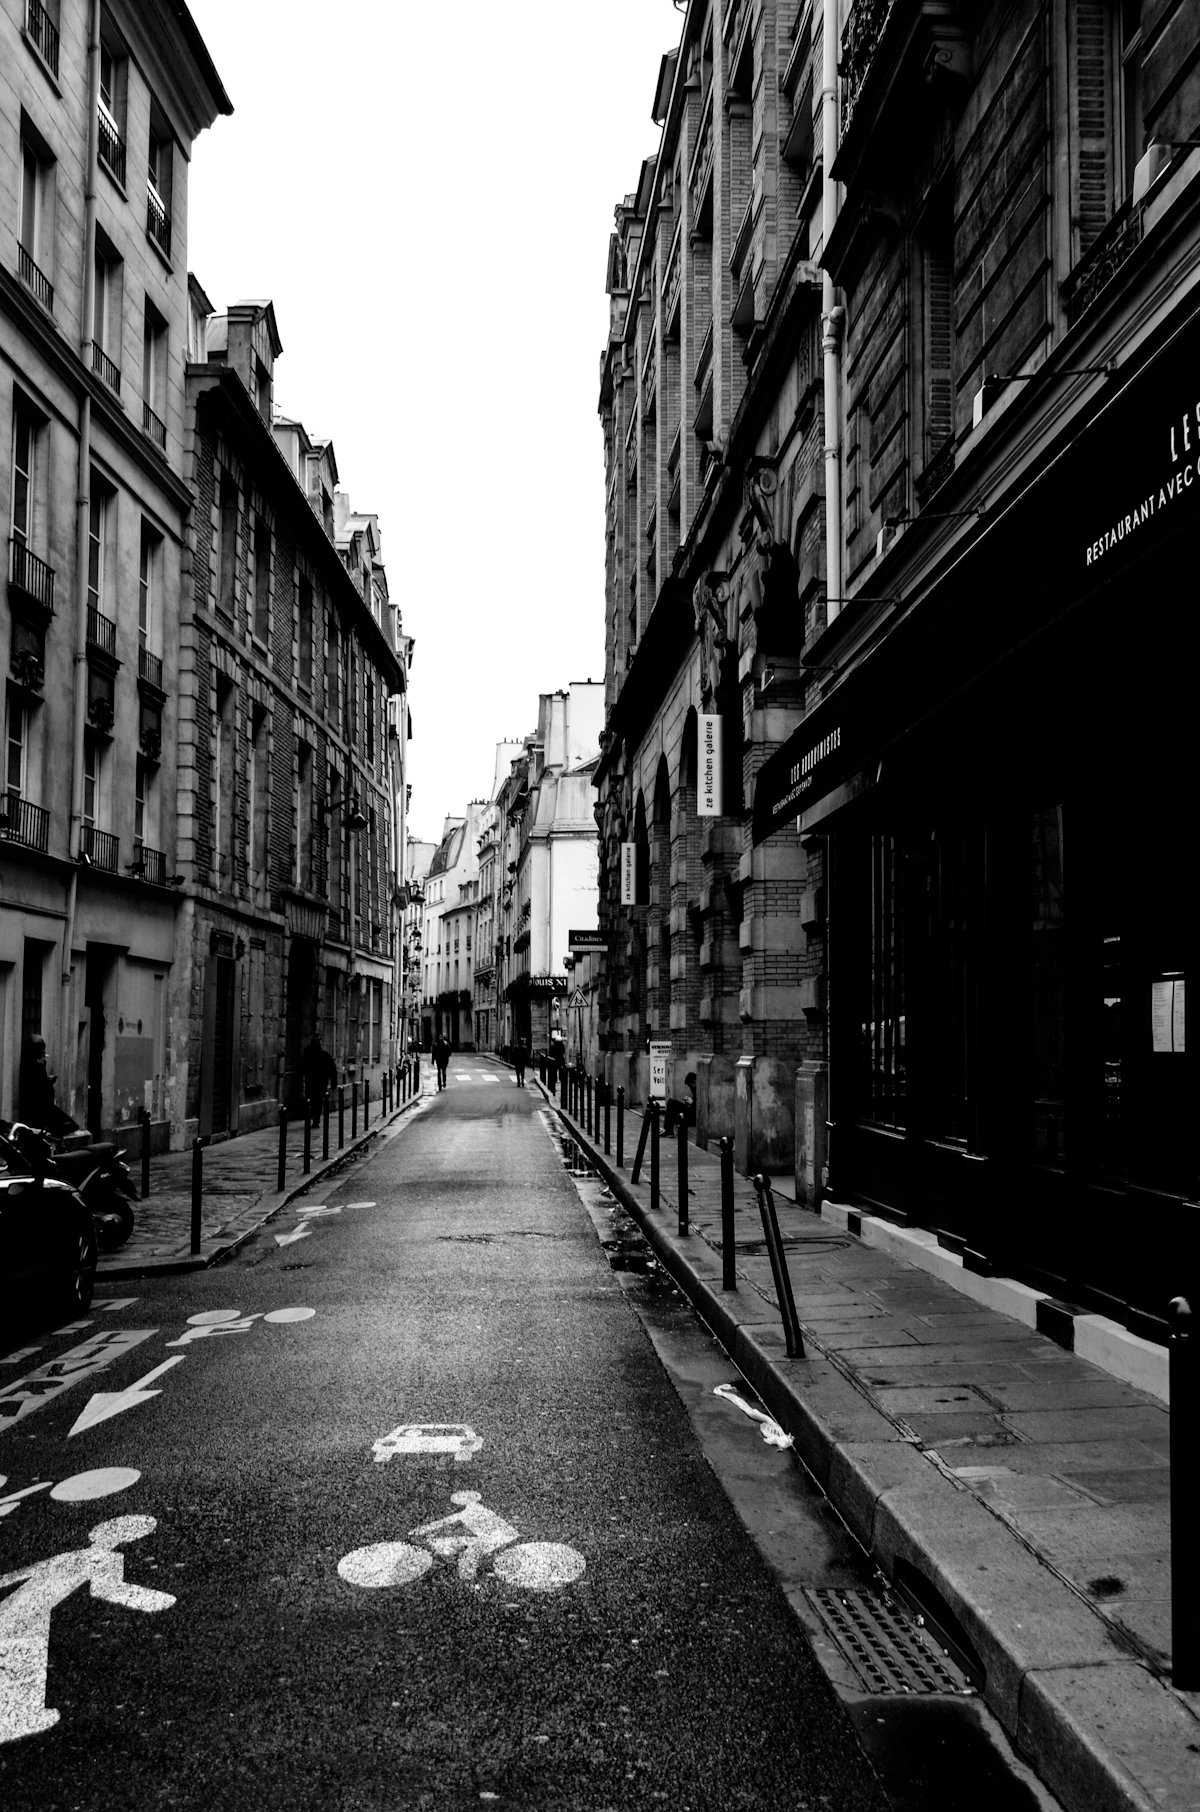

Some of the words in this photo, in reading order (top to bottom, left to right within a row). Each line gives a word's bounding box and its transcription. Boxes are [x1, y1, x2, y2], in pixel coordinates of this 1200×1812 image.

[1086, 494, 1155, 566] RESTAURANT
[1157, 464, 1194, 509] AVEC
[703, 721, 716, 755] galerie
[703, 758, 714, 794] kitchen
[705, 798, 714, 809] ze
